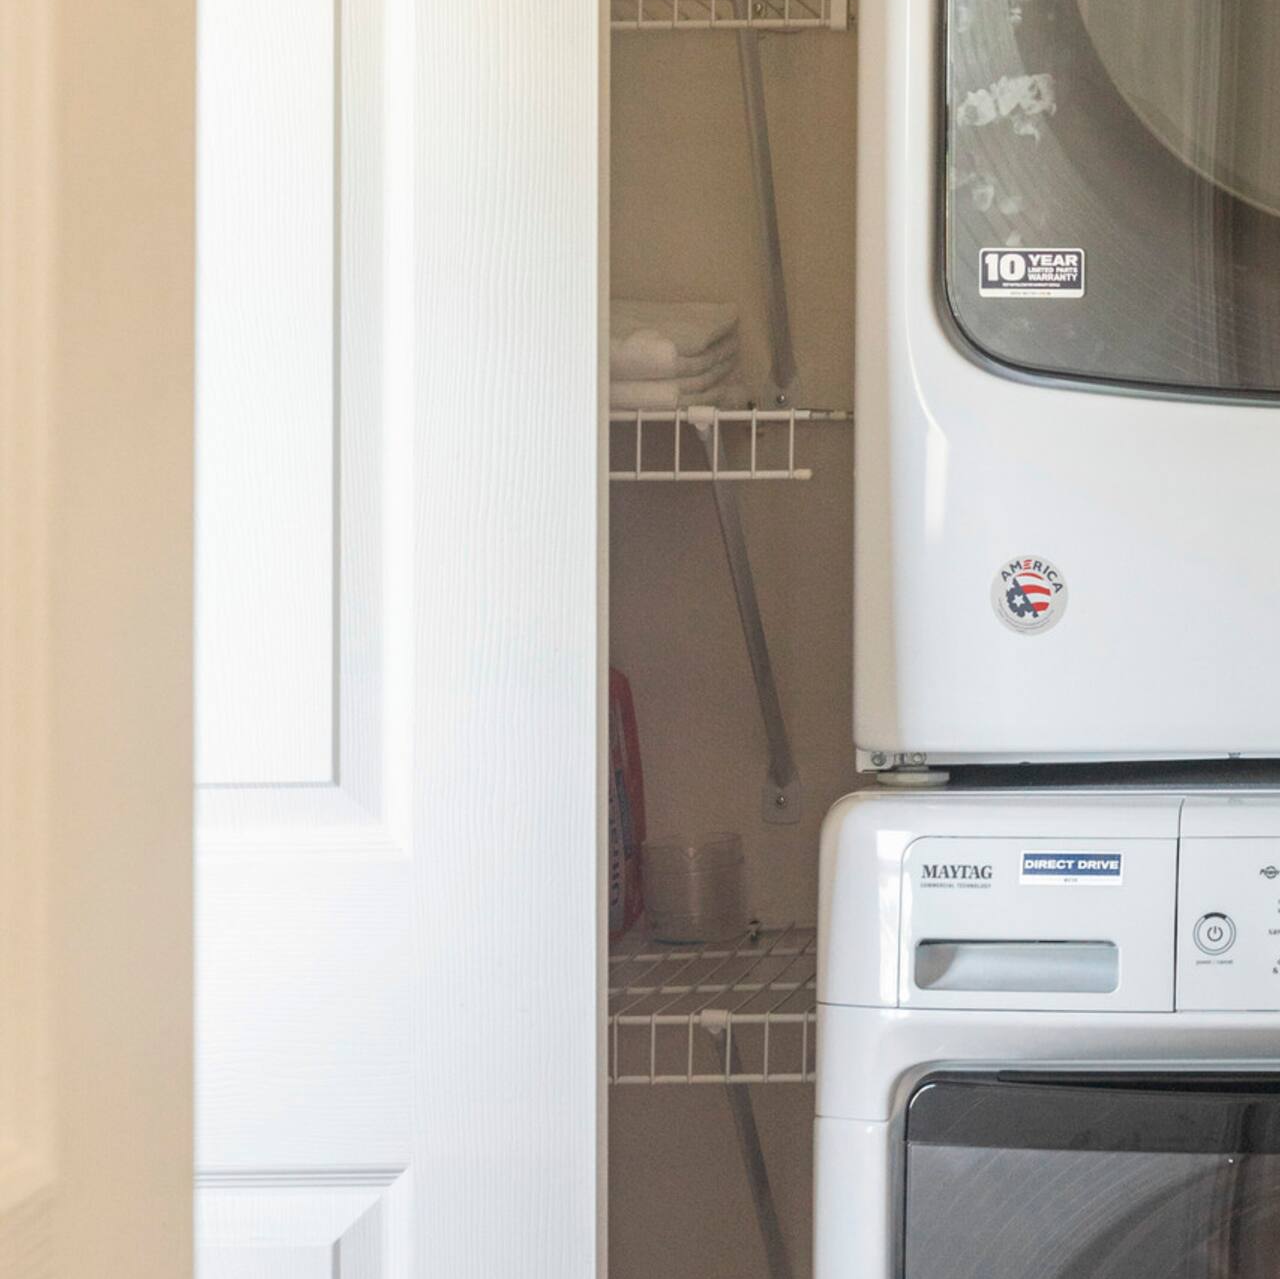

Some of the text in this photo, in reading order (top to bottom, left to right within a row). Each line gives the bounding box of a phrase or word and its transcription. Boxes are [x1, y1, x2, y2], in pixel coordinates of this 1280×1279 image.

[1028, 254, 1078, 266] YEAR
[984, 254, 1026, 282] 10
[1028, 273, 1078, 282] WARRANTY
[1001, 560, 1063, 593] AMERICA
[1024, 859, 1120, 870] DIRECT DRIVE
[922, 865, 992, 880] MAYTAG
